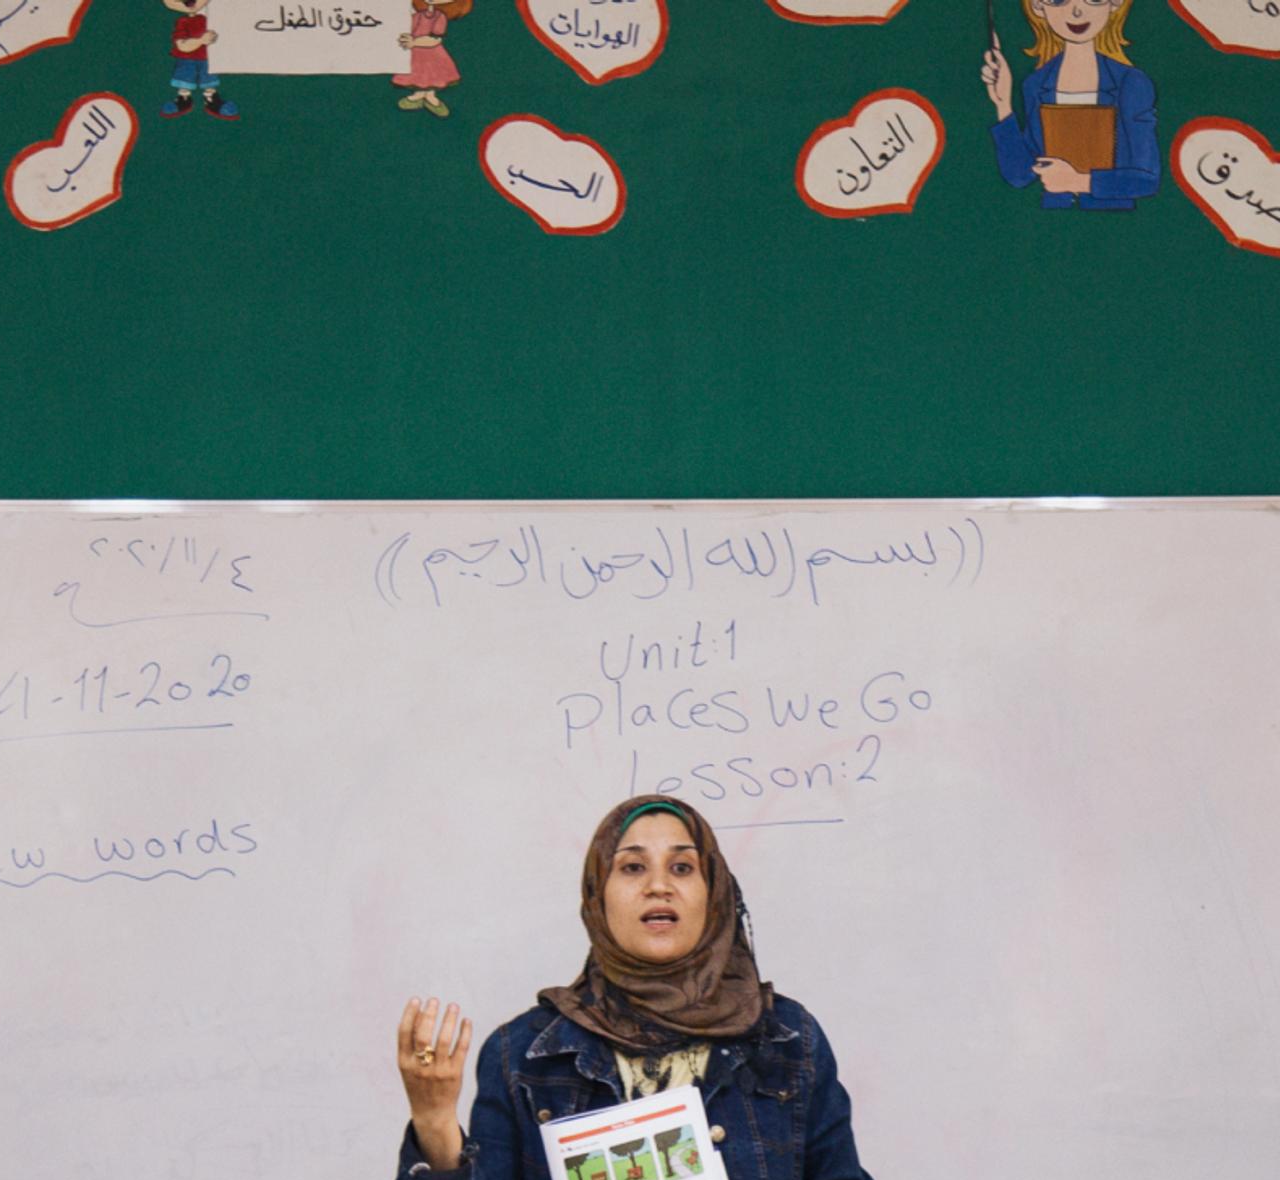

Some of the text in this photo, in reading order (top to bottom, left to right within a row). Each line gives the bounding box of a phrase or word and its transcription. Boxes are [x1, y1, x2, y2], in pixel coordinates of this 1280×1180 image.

[253, 3, 384, 36] حقوق الطفل
[548, 8, 641, 50] الهوايات
[46, 103, 117, 193] اللعب
[835, 111, 915, 196] التعاون
[506, 163, 605, 203] الحب
[560, 526, 694, 600] الرحمن
[704, 527, 796, 599] الله
[92, 819, 260, 863] words
